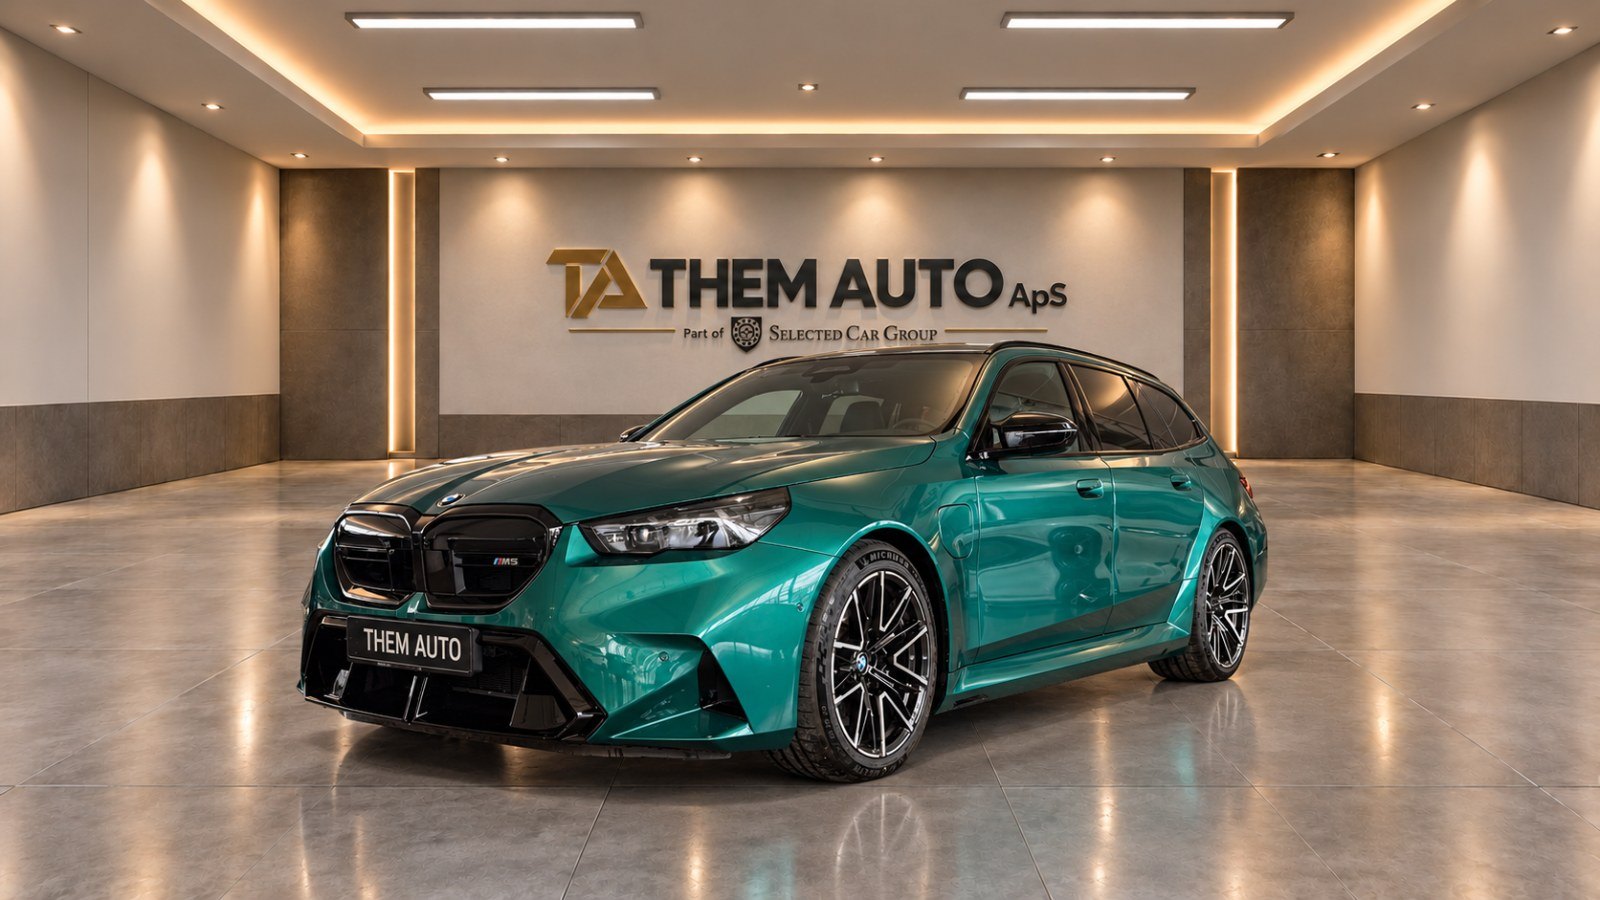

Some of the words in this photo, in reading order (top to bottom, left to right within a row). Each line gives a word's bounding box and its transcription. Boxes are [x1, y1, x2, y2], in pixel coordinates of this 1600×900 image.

[546, 248, 648, 319] TA
[649, 258, 817, 308] THEM
[829, 257, 1004, 308] AUTO
[1008, 282, 1068, 314] ApS
[683, 328, 708, 339] Part
[711, 327, 725, 339] of
[769, 324, 844, 341] SELECTED
[846, 325, 880, 341] CAR
[883, 325, 938, 341] GROUP
[363, 627, 410, 656] THEM
[414, 634, 461, 662] AUTO
